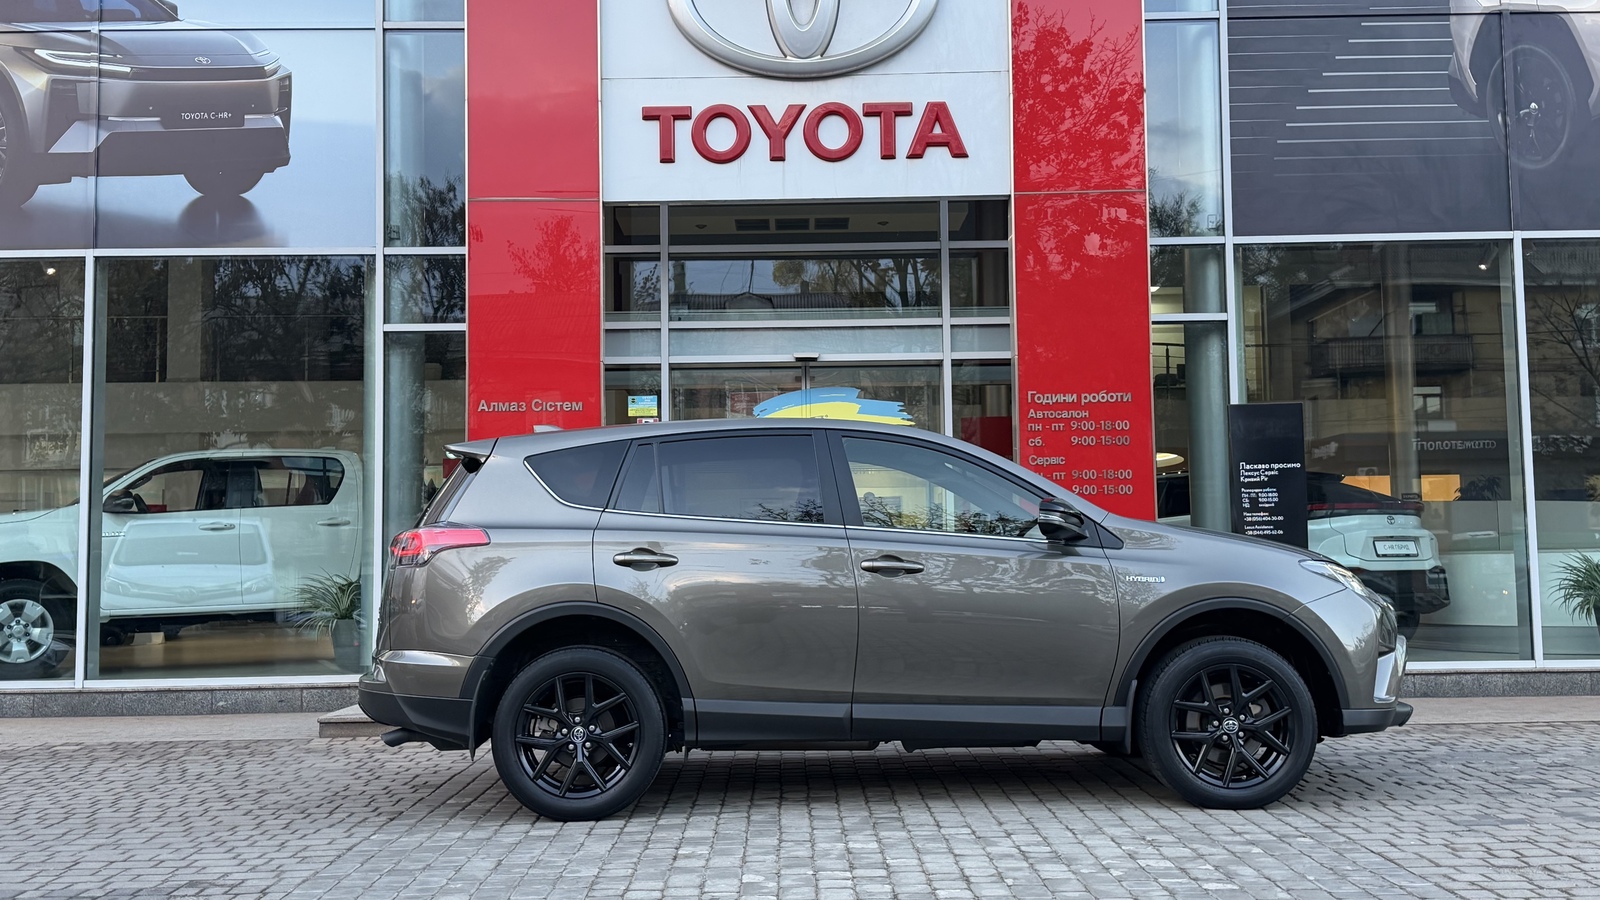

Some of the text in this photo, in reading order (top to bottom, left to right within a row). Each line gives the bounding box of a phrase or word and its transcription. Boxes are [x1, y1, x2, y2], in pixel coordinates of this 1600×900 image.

[181, 111, 232, 120] TOYOTA C-HR+
[642, 101, 969, 164] TOYOTA
[1027, 390, 1132, 405] Години роботи
[477, 398, 583, 412] Алмаз Сістем
[1028, 409, 1089, 419] Автосалон
[1027, 423, 1043, 431] пн
[1070, 420, 1130, 431] 9:00-18:00
[1028, 435, 1131, 447] сб. 9:00-15:00
[1028, 455, 1066, 467] Сервіс
[1270, 462, 1301, 470] просимо
[1071, 469, 1133, 480] 9:00-18:00
[1072, 484, 1133, 495] 9:00-15:00
